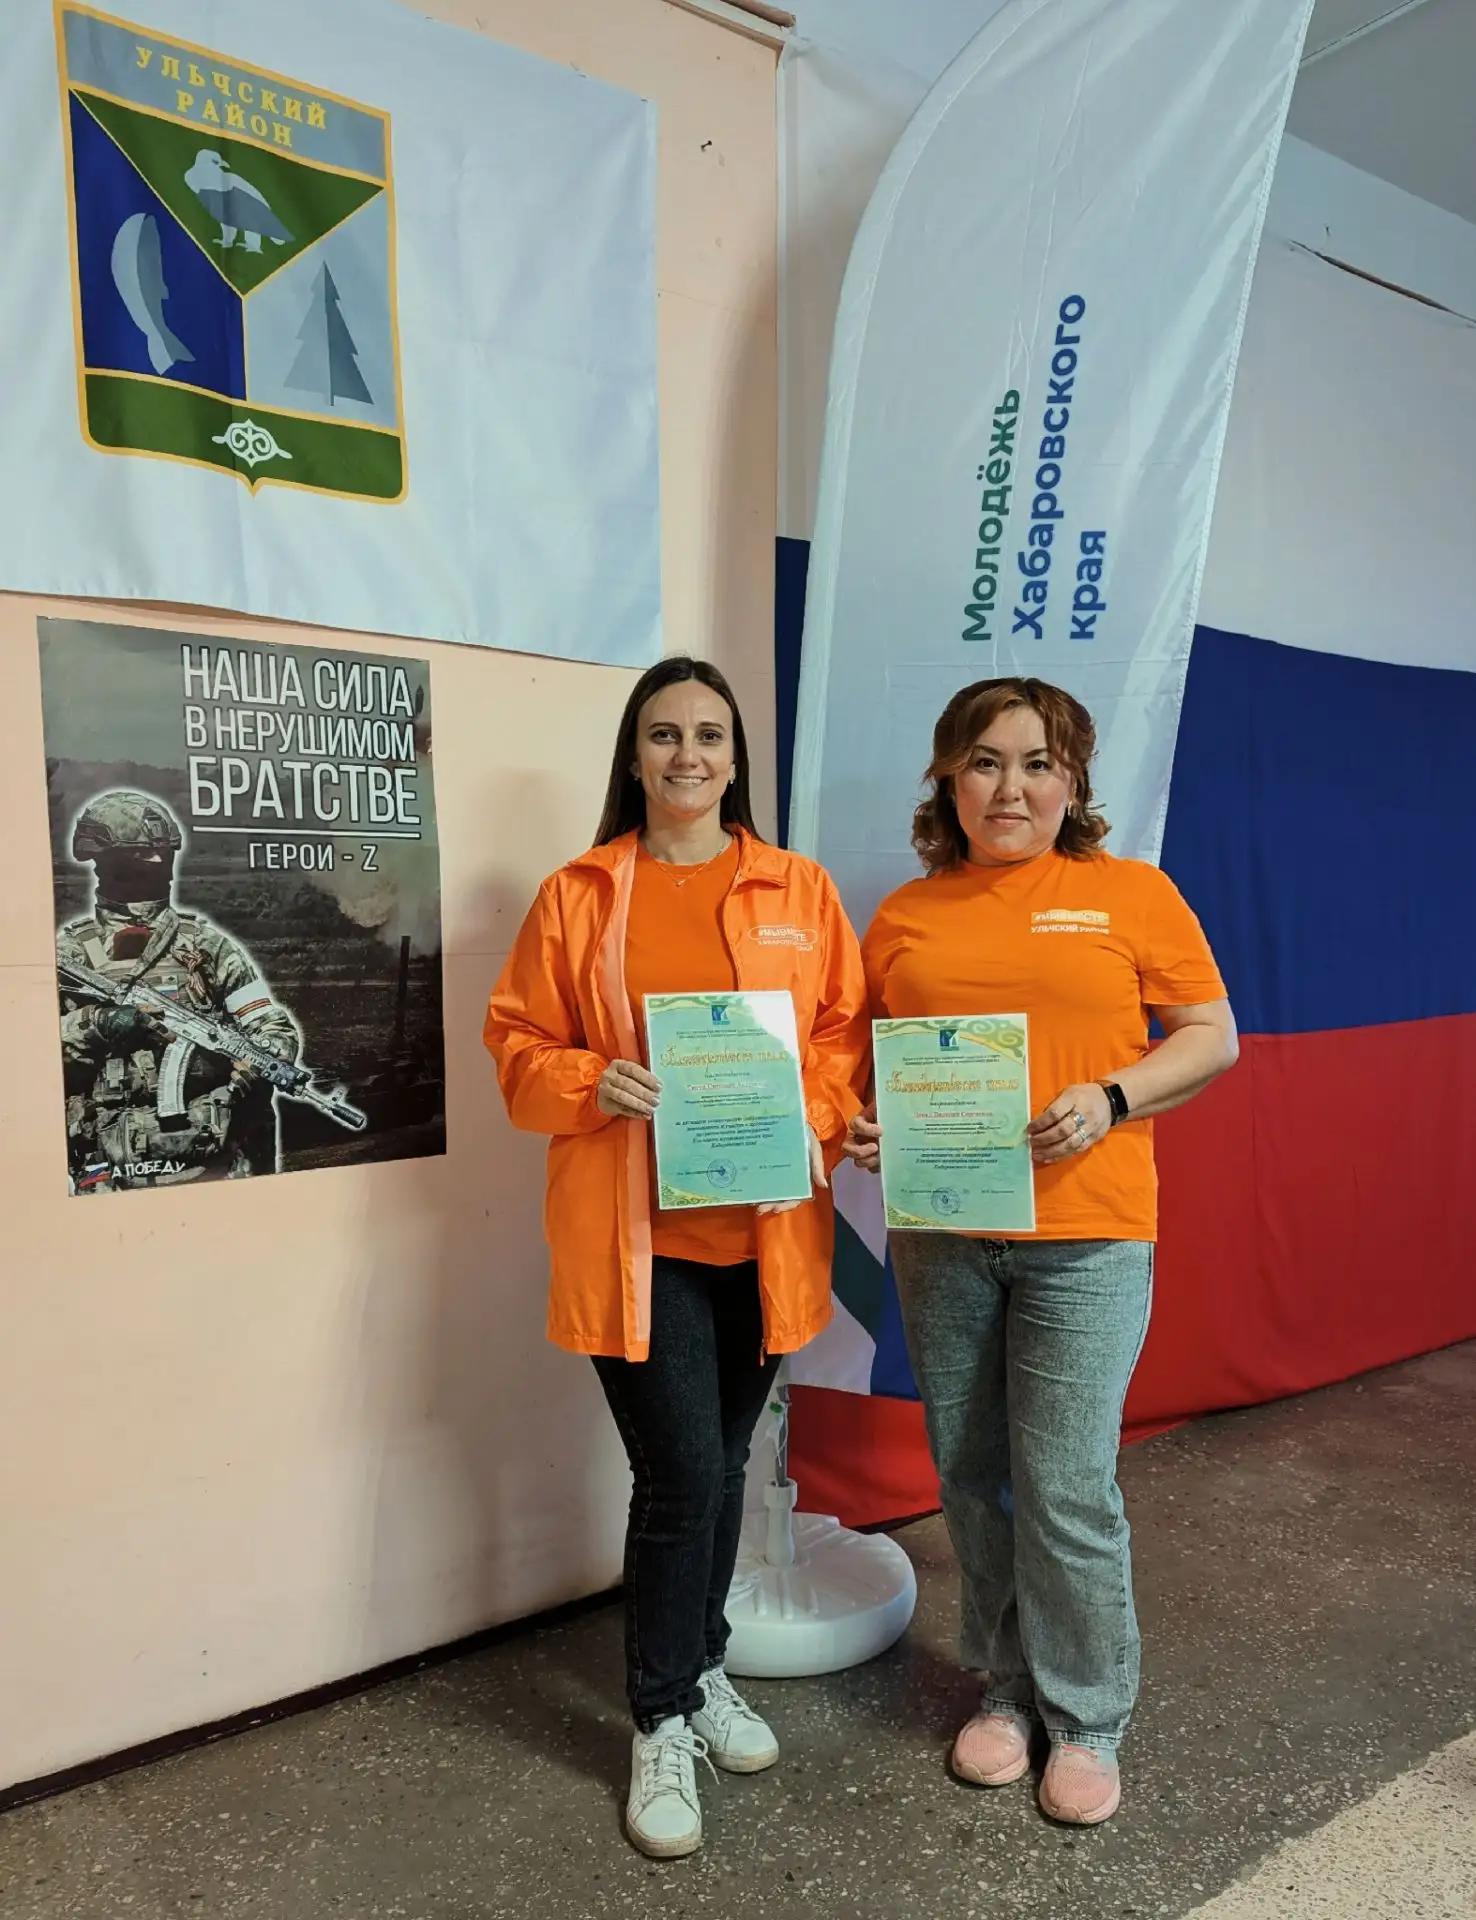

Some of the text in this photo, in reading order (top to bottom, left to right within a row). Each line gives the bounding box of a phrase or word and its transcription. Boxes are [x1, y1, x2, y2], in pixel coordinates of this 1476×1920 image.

[136, 46, 326, 129] УЛЬЧСКИЙ
[176, 89, 292, 147] РАЙОН
[1011, 294, 1086, 640] Хабаровского
[961, 389, 1020, 641] Молодёжь
[1069, 530, 1107, 640] края
[182, 645, 414, 717] НАША СИЛА
[185, 705, 416, 762] В НЕРУШИМОМ
[189, 755, 421, 825] БРАТСТВЕ
[249, 842, 334, 870] ГЕРОИ
[361, 844, 379, 871] Z
[124, 1160, 186, 1177] ПОБЕДУ
